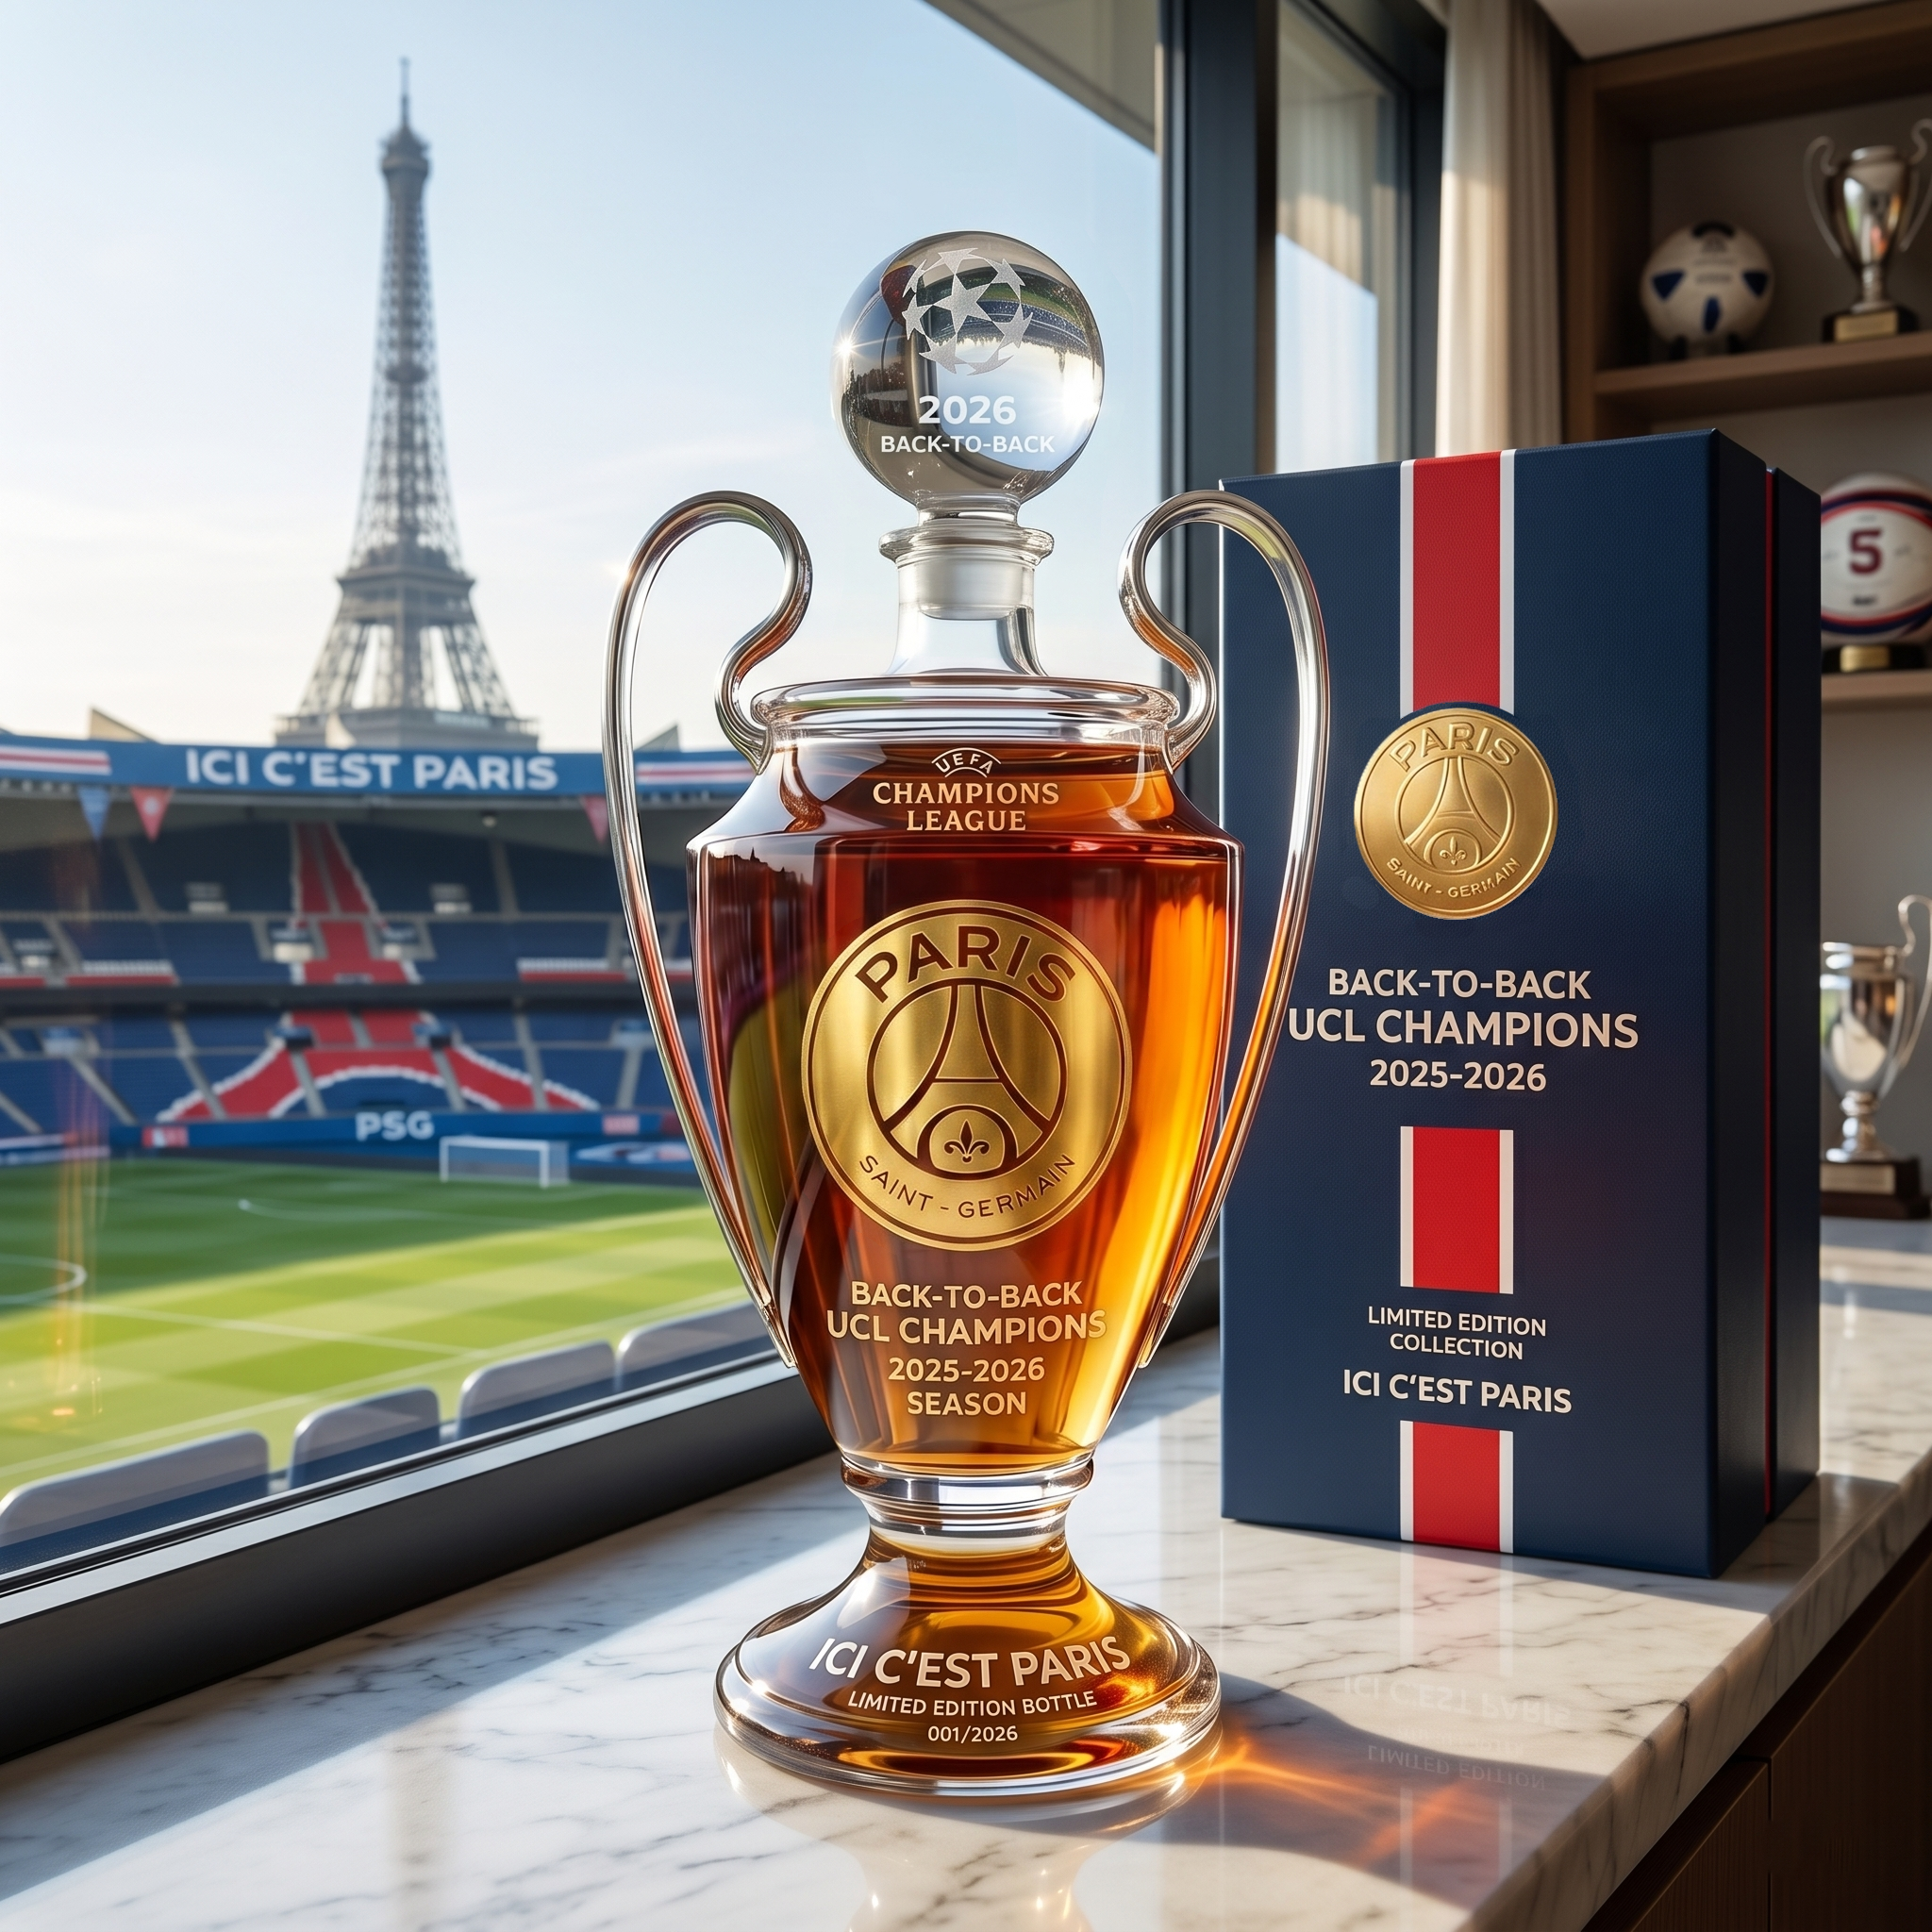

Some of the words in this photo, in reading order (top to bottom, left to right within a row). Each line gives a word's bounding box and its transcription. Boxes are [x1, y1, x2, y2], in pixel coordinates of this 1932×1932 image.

[918, 395, 1016, 425] 2026
[881, 435, 1055, 453] BACK-TO-BACK
[1848, 526, 1884, 575] 5
[1389, 722, 1520, 772] PARIS
[186, 748, 249, 784] ICI
[262, 751, 401, 789] C'EST
[413, 754, 558, 791] PARIS
[935, 753, 993, 774] UEFA
[873, 782, 1059, 805] CHAMPIONS
[907, 810, 1026, 831] LEAGUE
[855, 924, 1076, 1003] PARIS
[1329, 968, 1591, 1000] BACK-TO-BACK
[1288, 1008, 1366, 1042] UCL
[1375, 1008, 1640, 1049] CHAMPIONS
[1370, 1058, 1547, 1091] 2025-2026
[356, 1110, 435, 1142] PSG
[859, 1155, 934, 1211] SAINT
[958, 1154, 1075, 1218] GERMAIN
[851, 1281, 1082, 1308] BACK-TO-BACK
[826, 1310, 890, 1342] UCL
[899, 1309, 1107, 1345] CHAMPIONS
[1368, 1306, 1452, 1329] LIMITED
[1458, 1312, 1546, 1337] EDITION
[1390, 1333, 1523, 1360] COLLECTION
[888, 1357, 1045, 1382] 2025-2026
[907, 1391, 1026, 1416] SEASON
[1343, 1369, 1380, 1397] ICI
[1389, 1374, 1473, 1405] C'EST
[1481, 1381, 1573, 1414] PARIS
[809, 1638, 869, 1678] ICI
[874, 1649, 998, 1688] C'EST
[1010, 1636, 1131, 1687] PARIS
[848, 1690, 926, 1715] LIMITED
[933, 1700, 1016, 1717] EDITION
[1024, 1690, 1097, 1715] BOTTLE
[927, 1724, 1019, 1743] 001/2026
